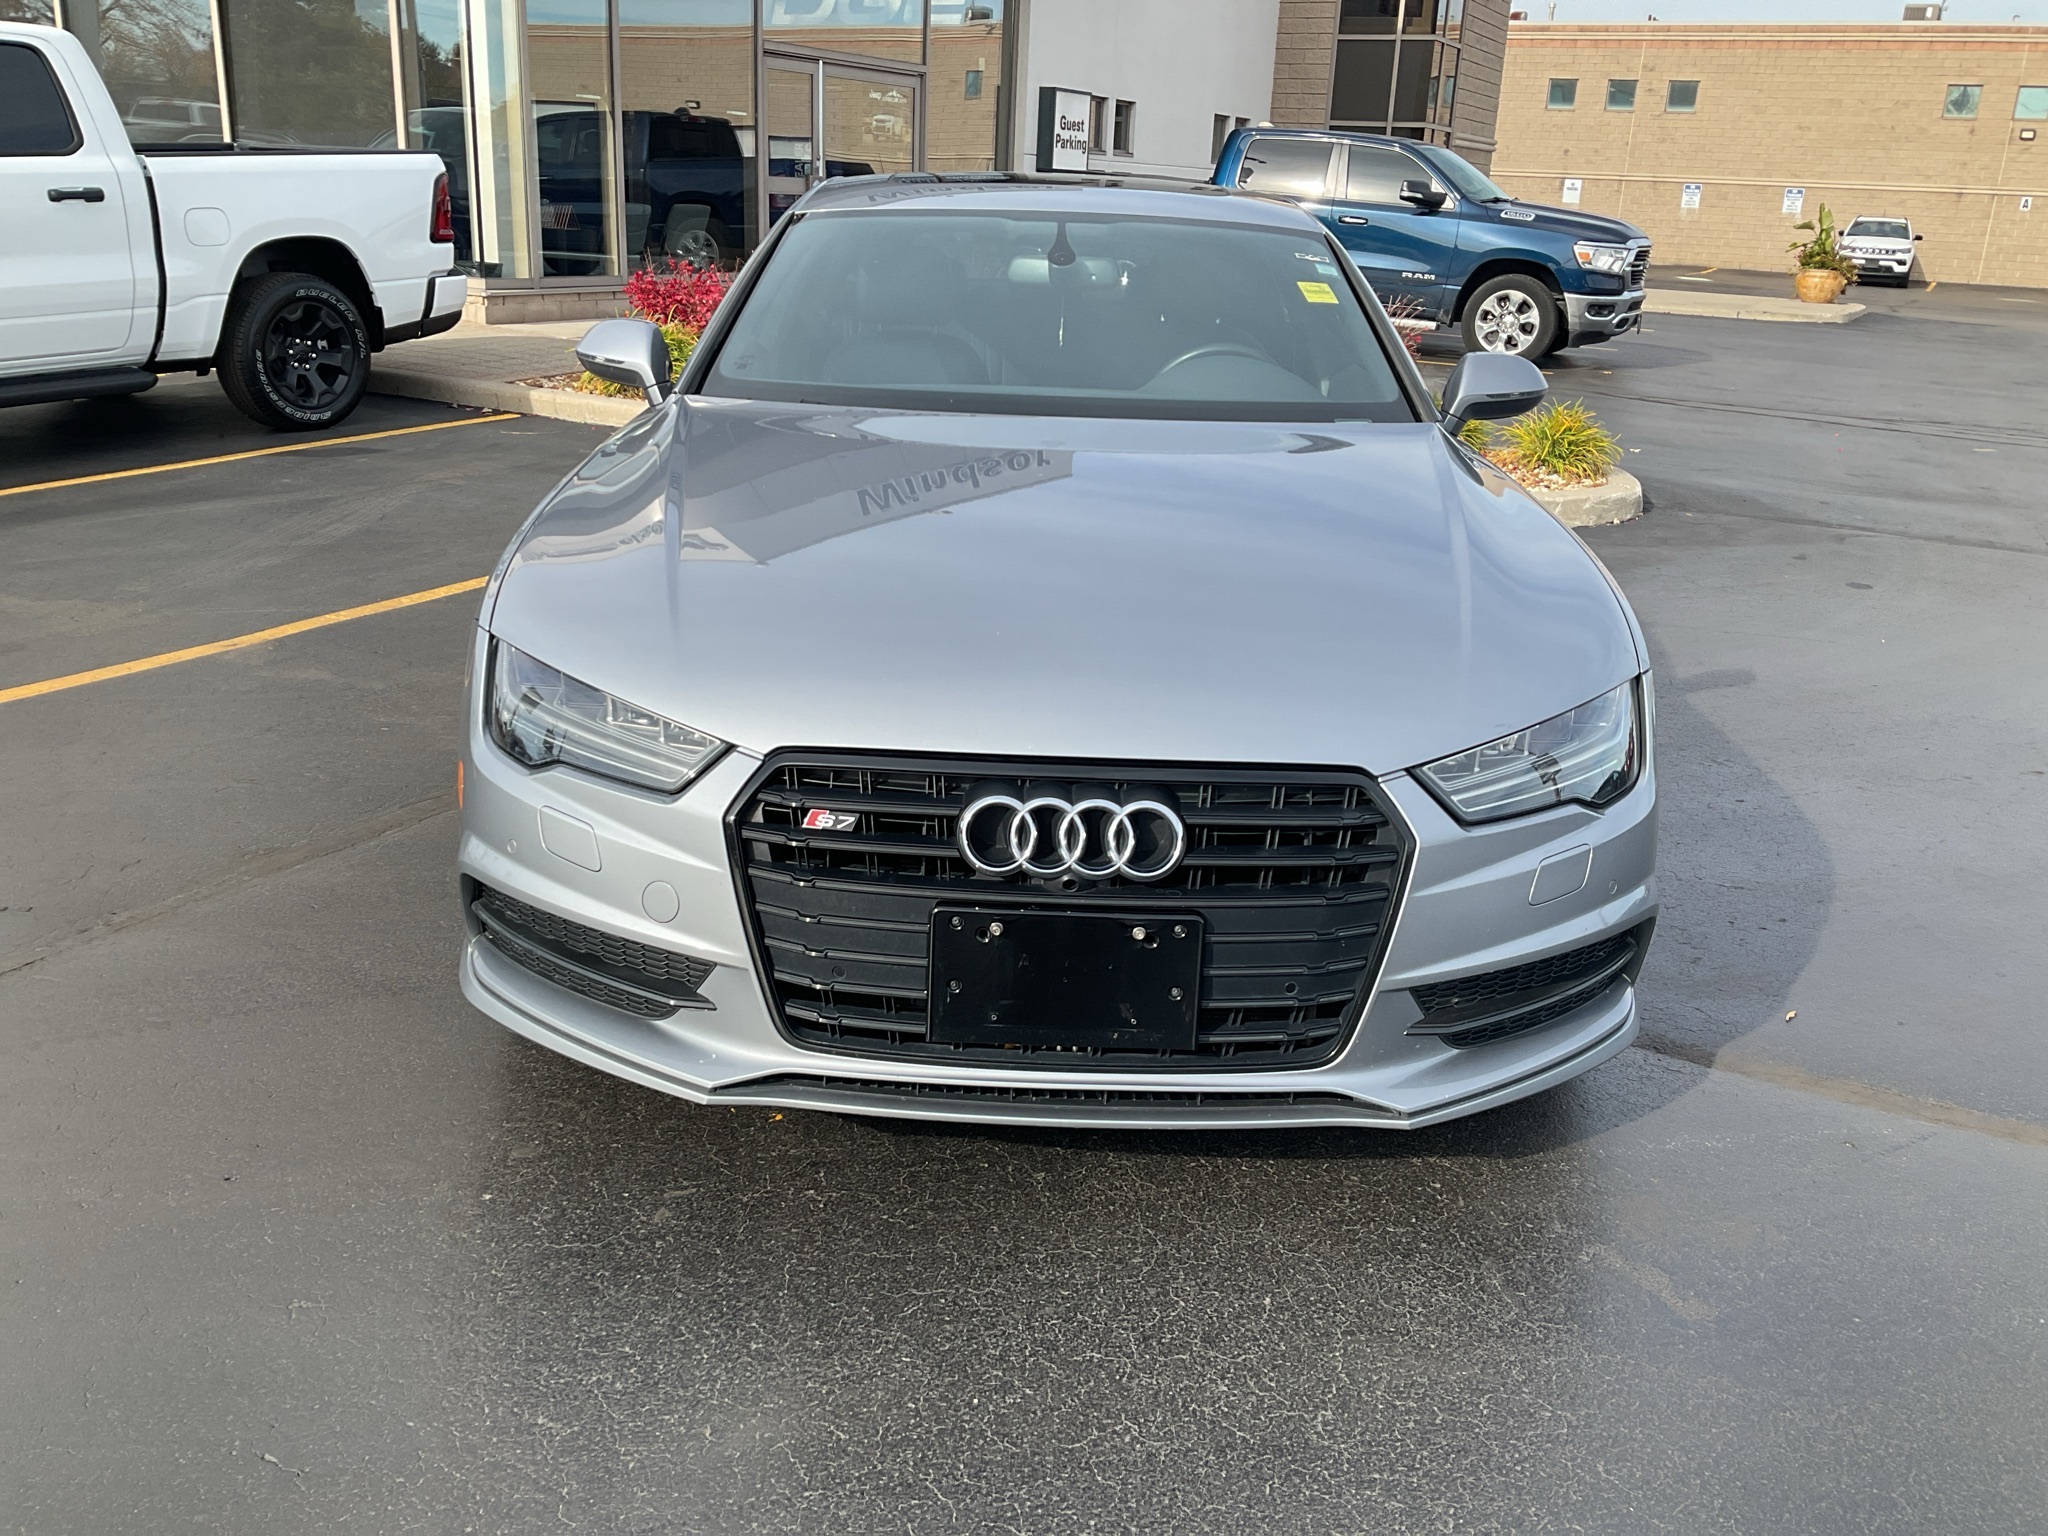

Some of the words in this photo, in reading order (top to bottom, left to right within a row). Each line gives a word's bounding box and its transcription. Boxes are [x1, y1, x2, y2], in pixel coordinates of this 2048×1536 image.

[1060, 115, 1085, 132] Guest
[1055, 133, 1087, 154] Parking
[2022, 198, 2029, 209] A
[1401, 271, 1436, 280] RAM
[296, 288, 356, 321] DUELER
[256, 349, 331, 420] BRIDGESTONE
[812, 812, 857, 830] S7
